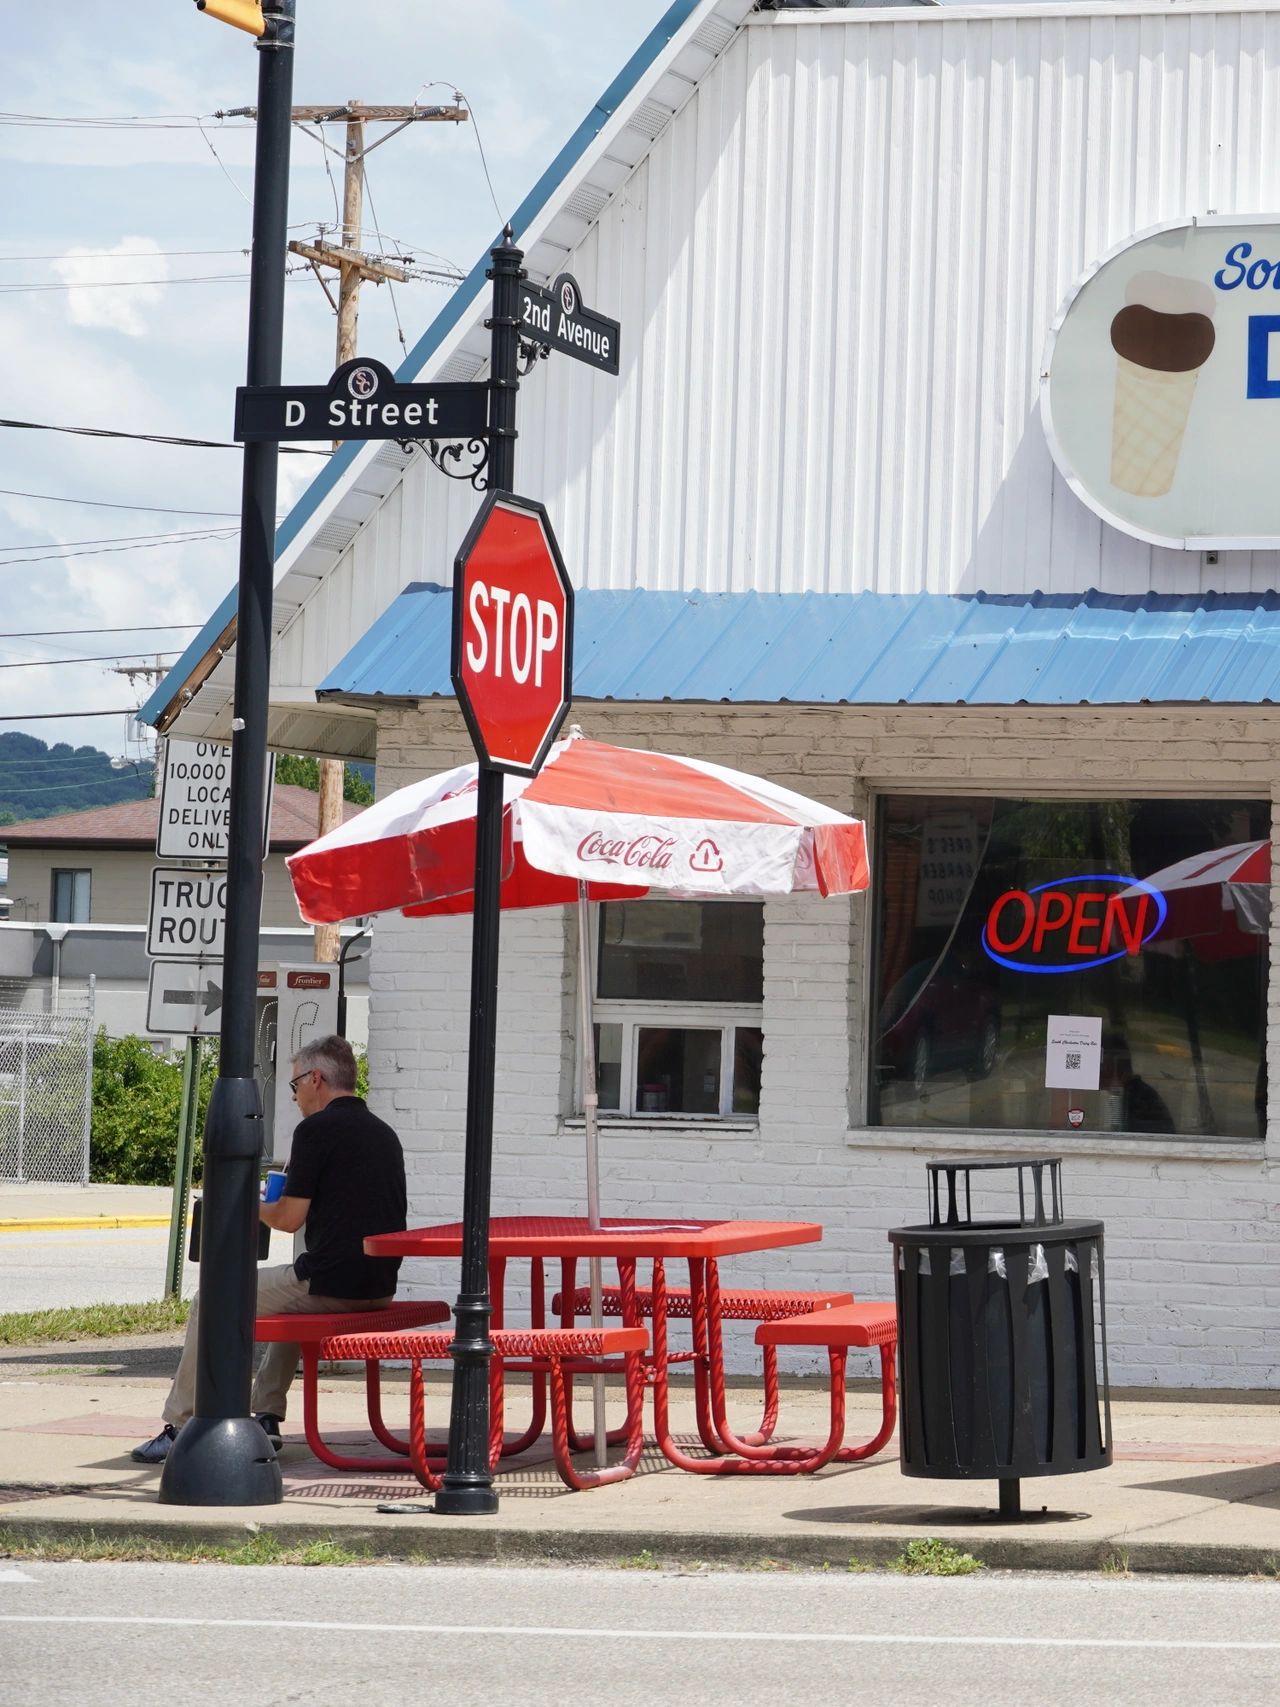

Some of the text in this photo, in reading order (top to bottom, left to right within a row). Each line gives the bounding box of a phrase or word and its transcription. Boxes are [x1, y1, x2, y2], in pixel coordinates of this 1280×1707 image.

[523, 296, 610, 358] 2nd Avenue
[285, 398, 439, 427] D Street
[466, 580, 559, 688] STOP
[196, 742, 232, 758] OVE
[169, 763, 226, 781] 10,000
[187, 786, 232, 803] LOCA
[576, 830, 678, 869] Coca-Cola
[159, 880, 228, 909] TRUC
[987, 889, 1149, 956] OPEN
[293, 975, 322, 986] frontier
